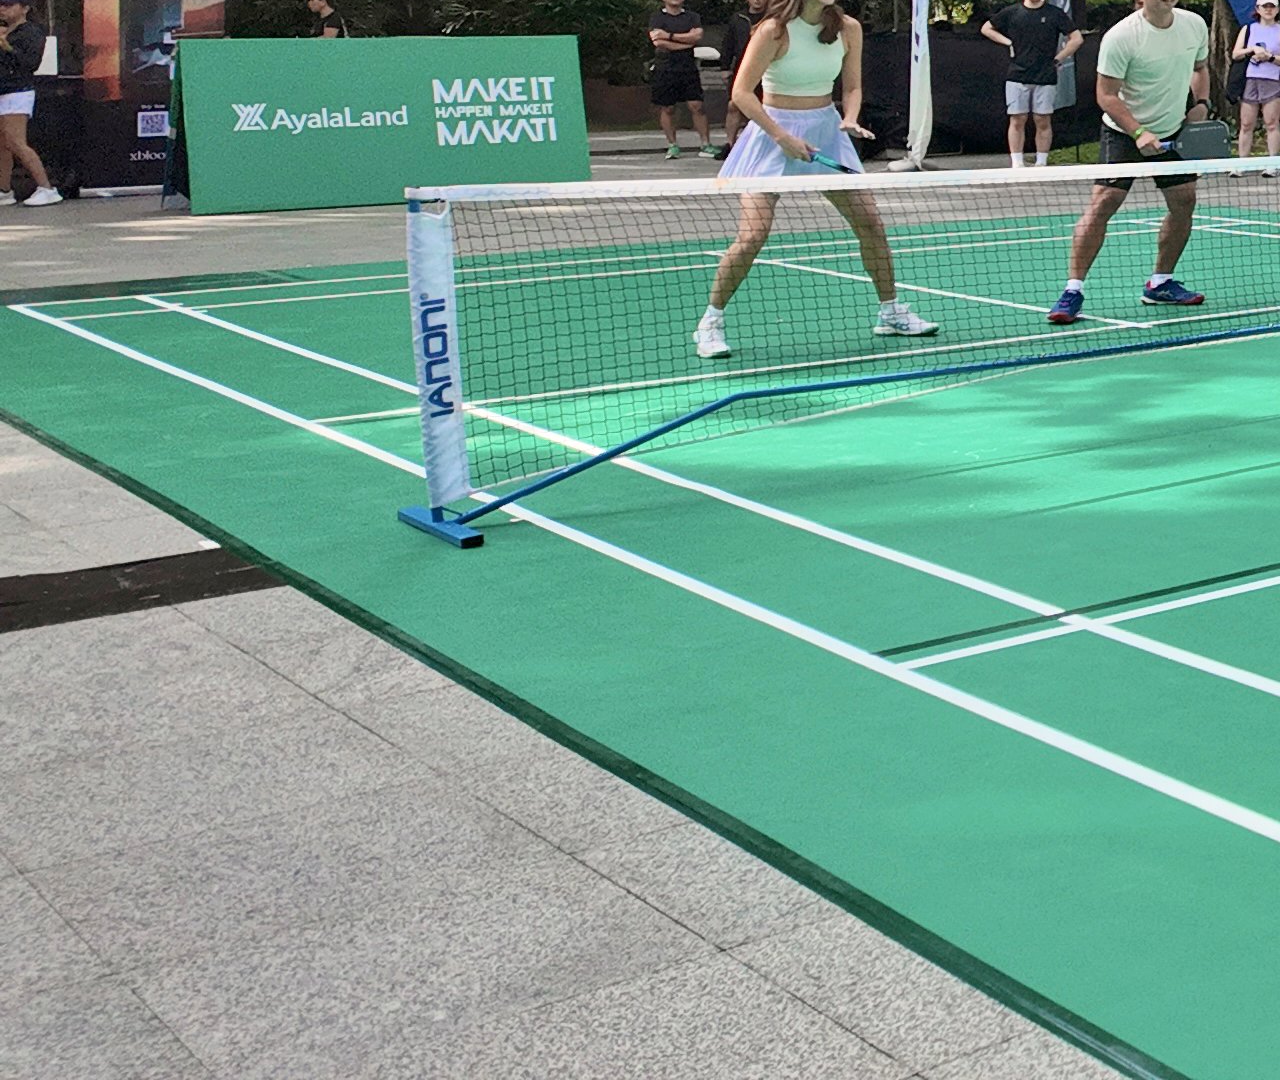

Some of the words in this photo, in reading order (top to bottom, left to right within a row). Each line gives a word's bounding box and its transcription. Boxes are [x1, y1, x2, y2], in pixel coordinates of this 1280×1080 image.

[432, 77, 527, 104] MAKE
[531, 77, 555, 101] IT
[270, 105, 408, 134] AyalaLand
[434, 105, 493, 119] HAPPEN
[499, 104, 541, 116] MAKE
[436, 118, 557, 146] MAKATI
[129, 150, 167, 161] xbloo
